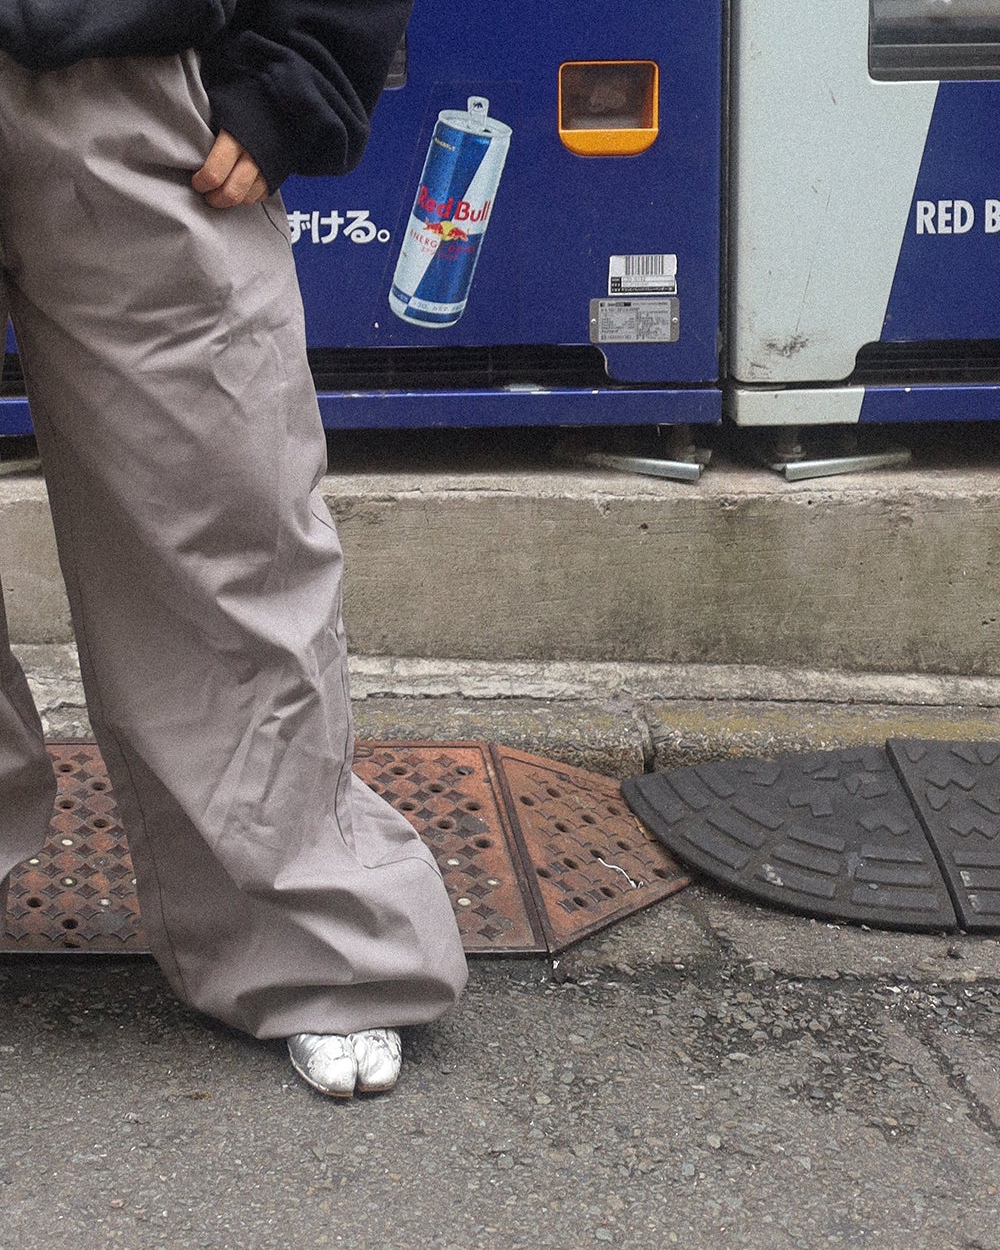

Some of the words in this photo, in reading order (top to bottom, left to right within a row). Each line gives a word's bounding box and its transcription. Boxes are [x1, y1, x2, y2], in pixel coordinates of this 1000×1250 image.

[416, 184, 455, 219] Red
[453, 199, 492, 224] Bull
[915, 199, 975, 236] RED
